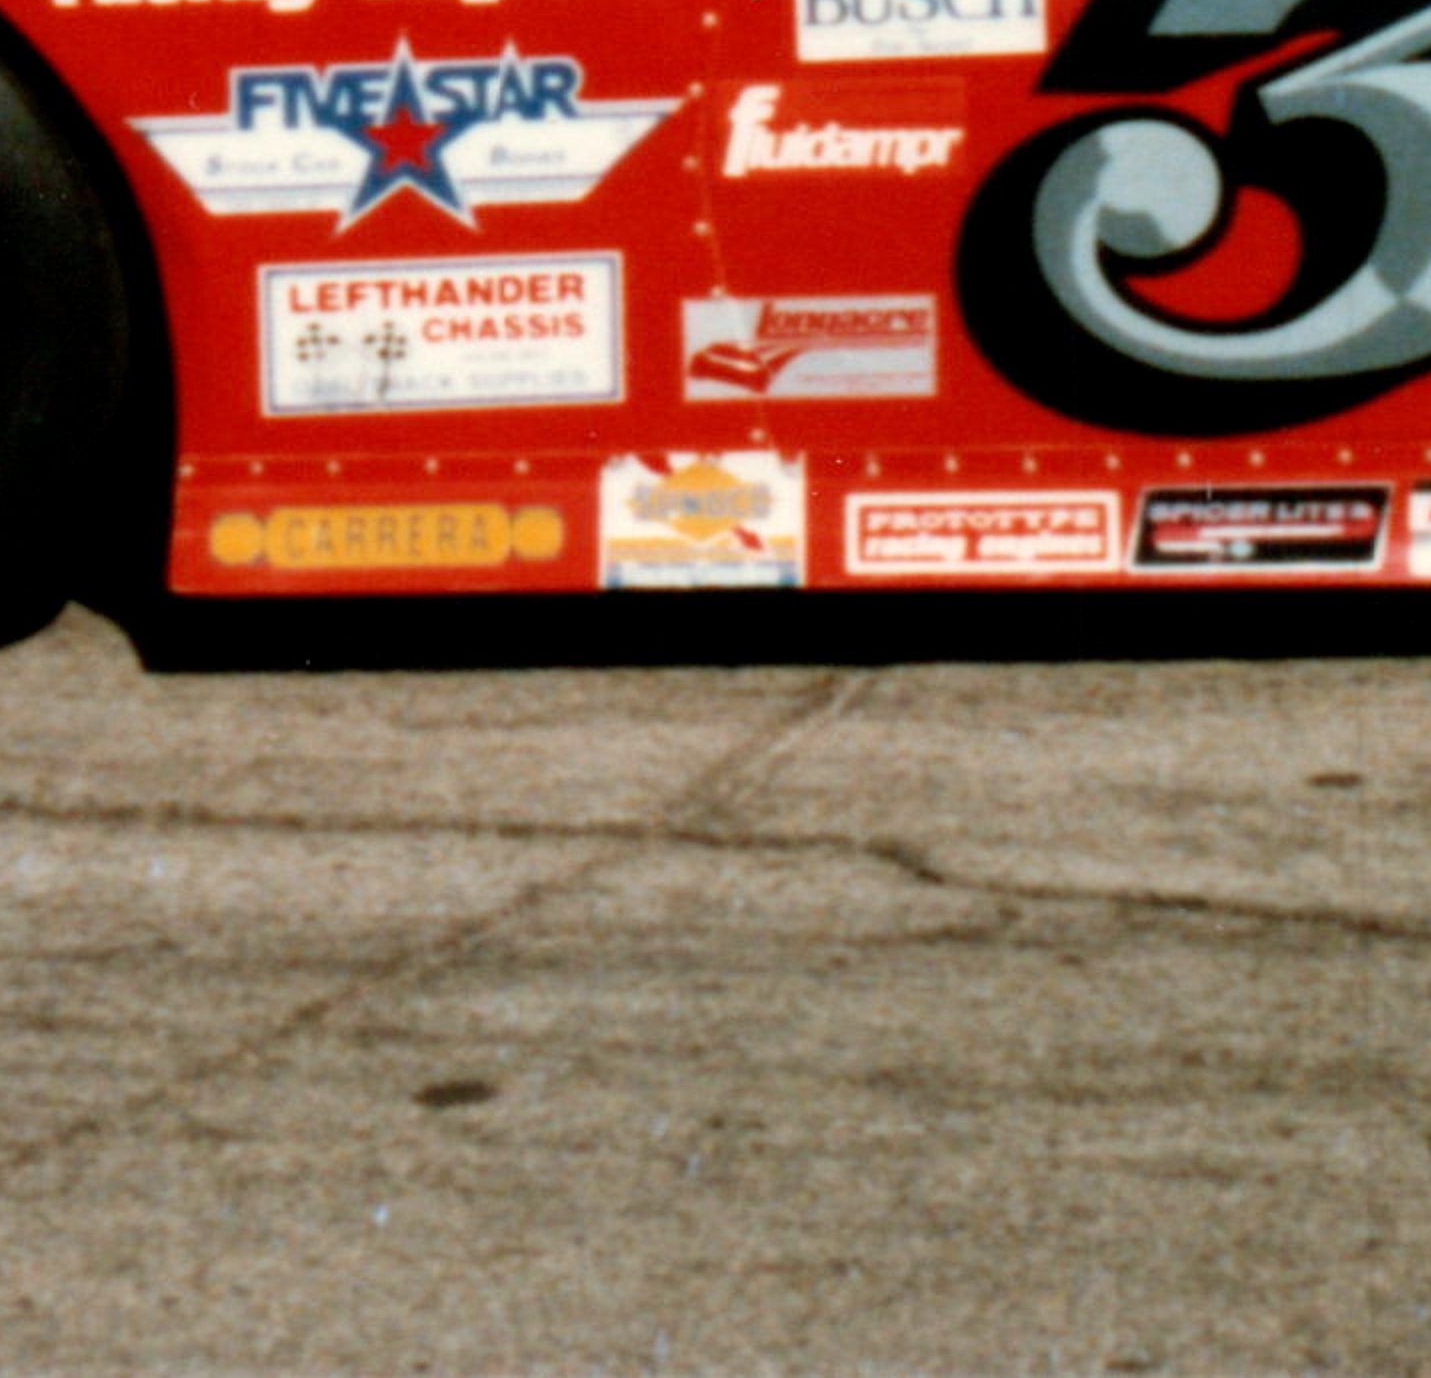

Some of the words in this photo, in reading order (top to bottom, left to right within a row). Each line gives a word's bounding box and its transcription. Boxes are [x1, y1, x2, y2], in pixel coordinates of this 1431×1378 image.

[425, 58, 579, 124] STAR
[289, 273, 585, 314] LEFTHANDER
[421, 312, 585, 343] CHASSIS
[282, 512, 493, 558] CARRERA
[868, 507, 1099, 531] PROTOTYPE
